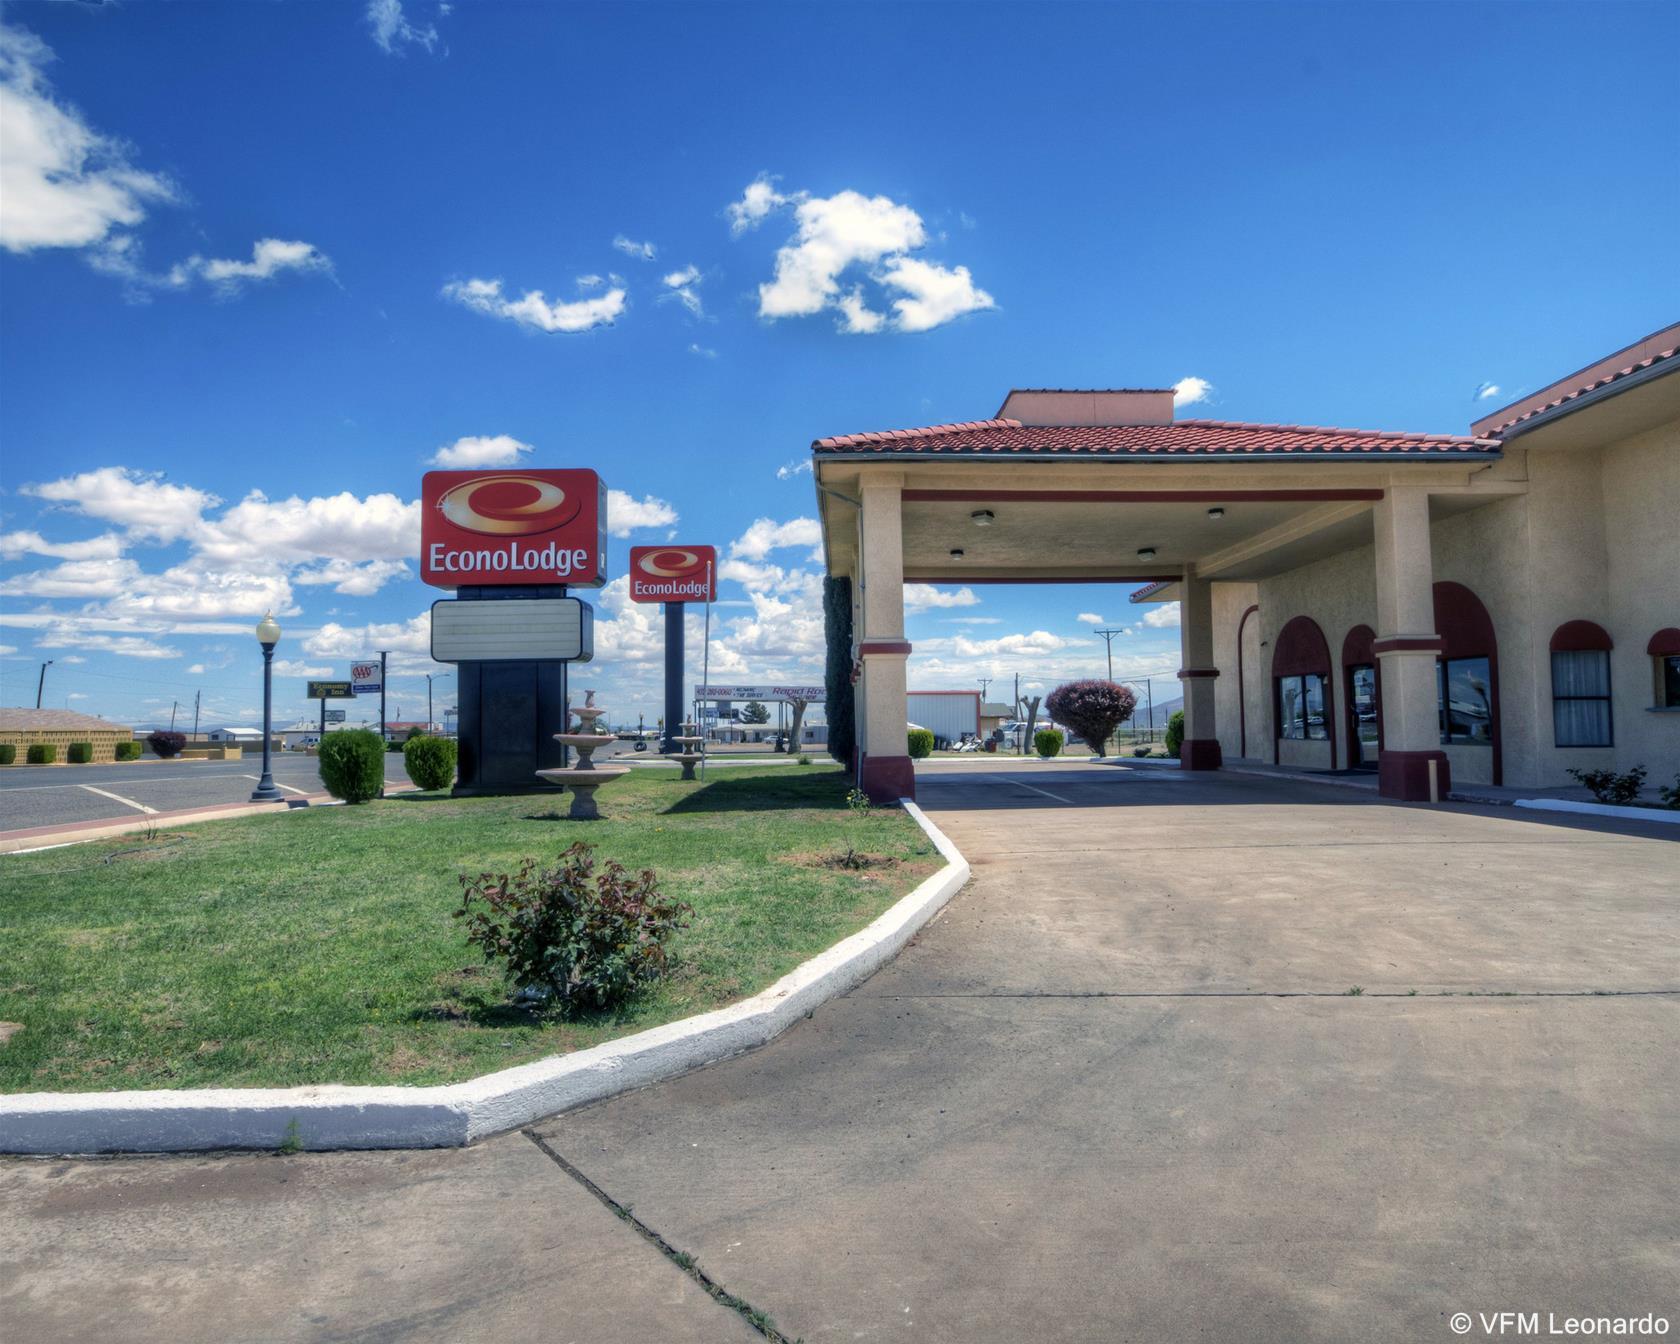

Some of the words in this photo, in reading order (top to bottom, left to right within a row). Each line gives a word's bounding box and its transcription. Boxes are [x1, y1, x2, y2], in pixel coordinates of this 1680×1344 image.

[429, 541, 588, 577] EconoLodge
[635, 580, 709, 597] EconoLodge
[772, 687, 804, 696] Rapid
